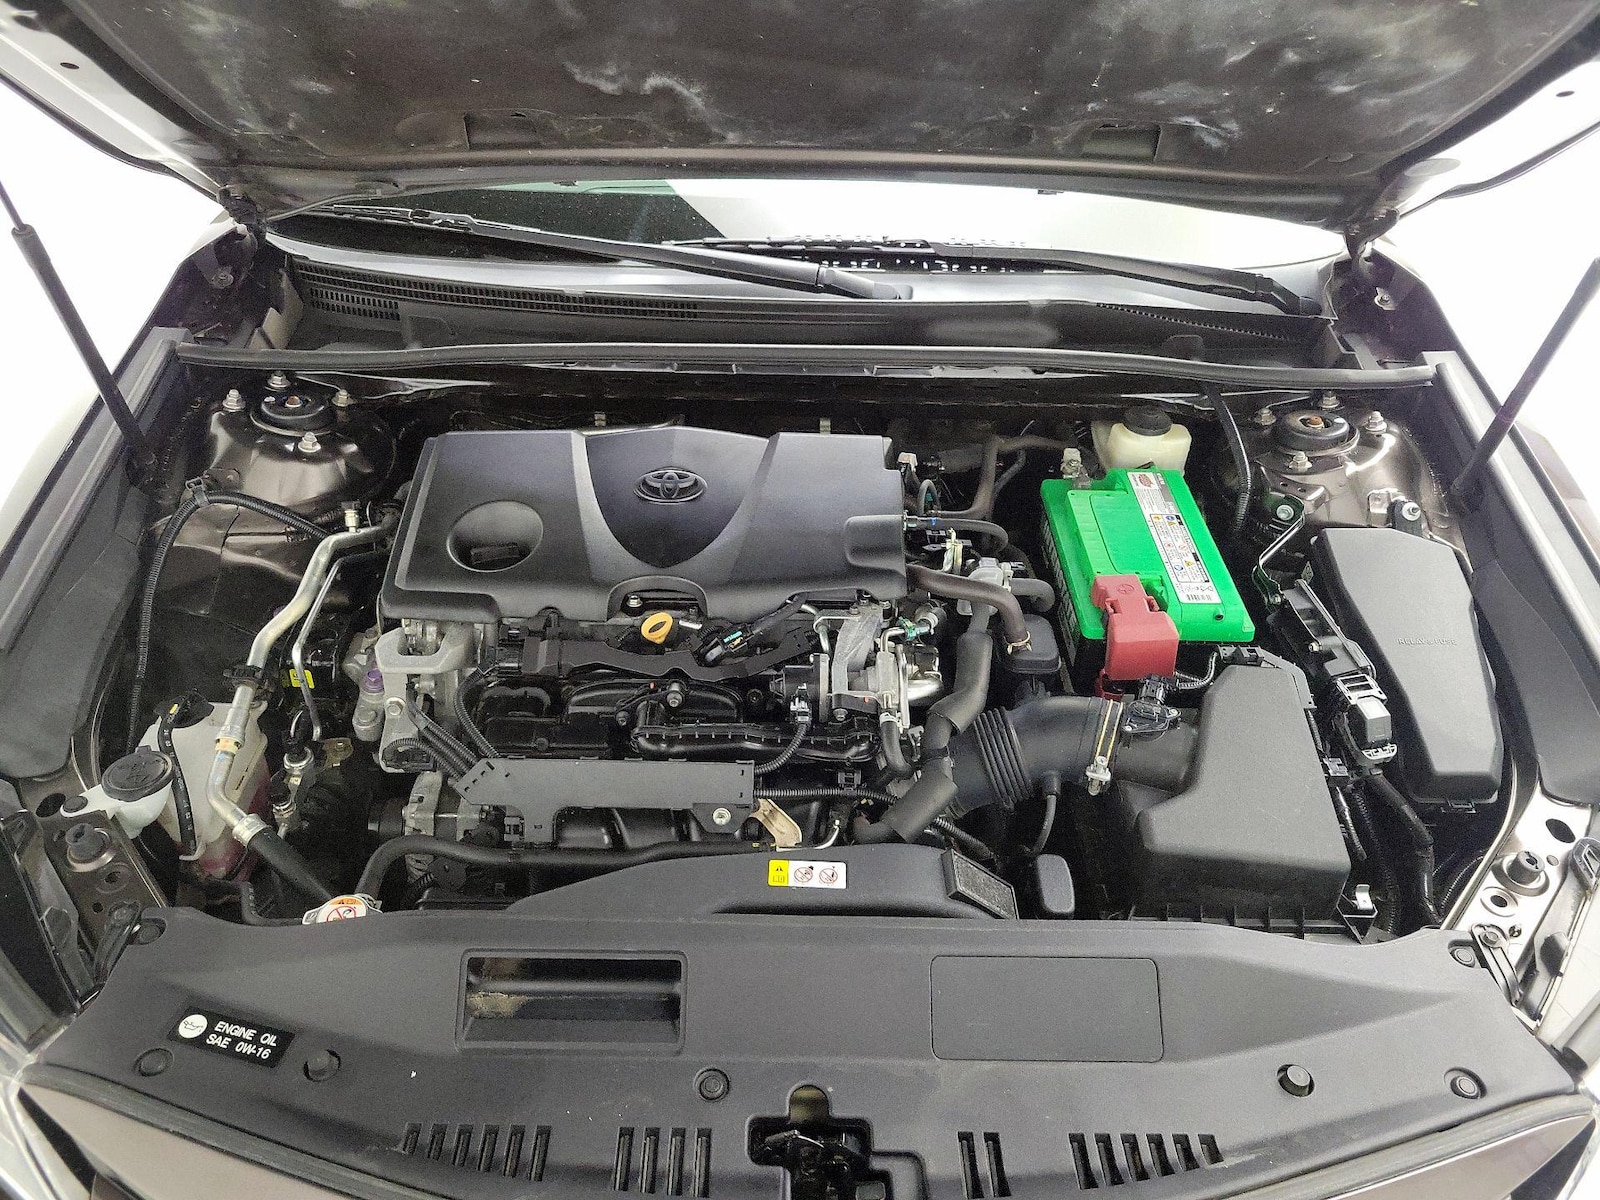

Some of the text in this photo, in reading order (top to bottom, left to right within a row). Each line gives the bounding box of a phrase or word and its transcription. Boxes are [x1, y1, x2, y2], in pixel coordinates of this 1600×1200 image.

[206, 1034, 272, 1060] SAE 0W-16
[214, 1021, 278, 1047] ENGINE OIL
